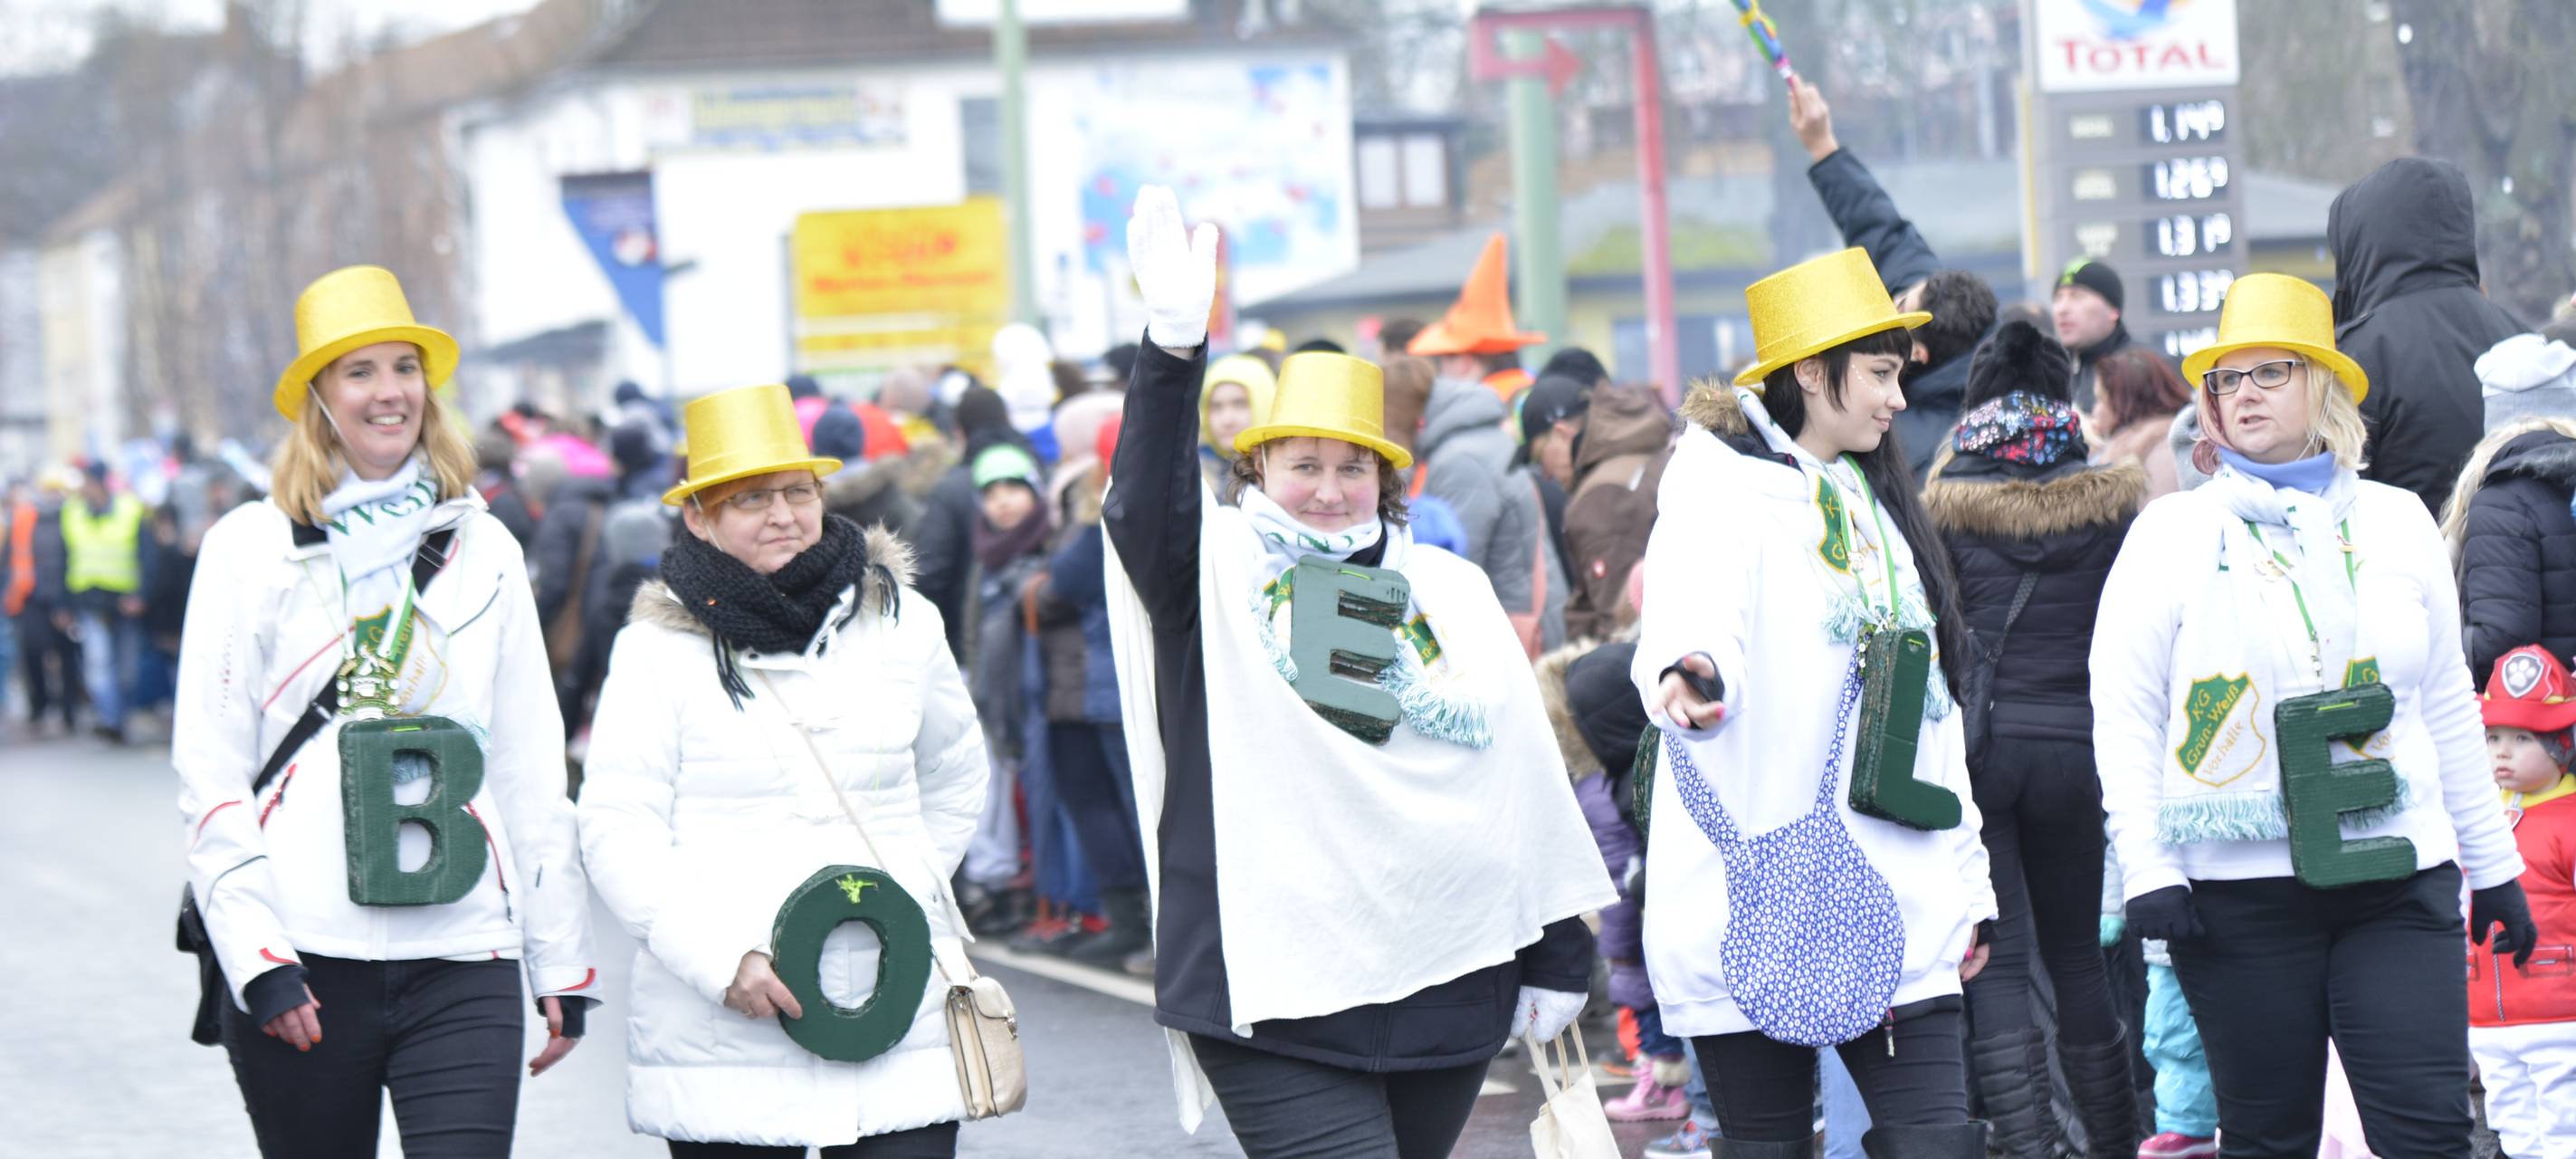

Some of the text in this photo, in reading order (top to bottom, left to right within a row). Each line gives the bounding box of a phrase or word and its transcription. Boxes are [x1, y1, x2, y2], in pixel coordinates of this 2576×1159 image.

[2057, 38, 2227, 72] TOTAL
[1290, 554, 1410, 746] E
[1848, 628, 1962, 831] L
[2192, 688, 2210, 722] KG
[338, 714, 489, 907] B
[2203, 721, 2243, 775] Vorhalle
[2274, 682, 2418, 889] E
[771, 864, 932, 1062] O
